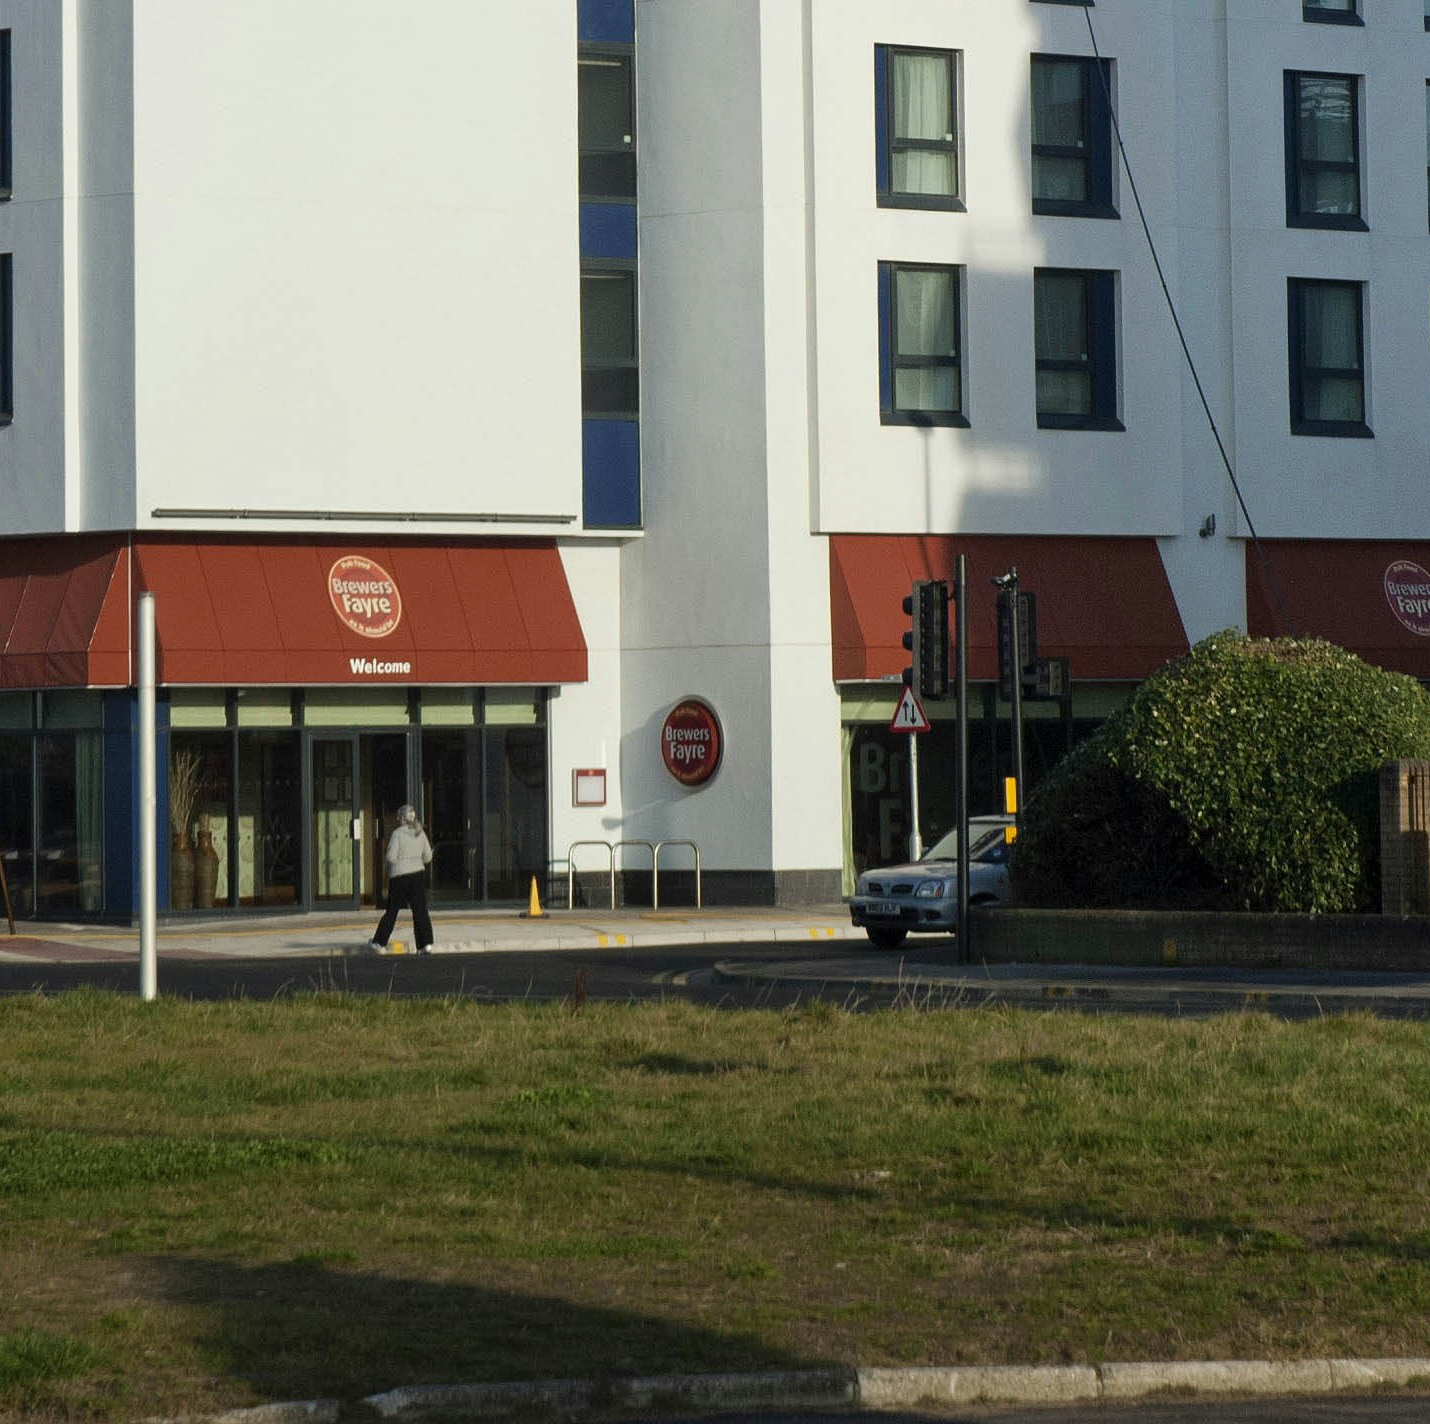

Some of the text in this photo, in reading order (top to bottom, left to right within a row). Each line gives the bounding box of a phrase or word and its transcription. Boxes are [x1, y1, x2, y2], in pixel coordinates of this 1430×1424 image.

[332, 578, 393, 595] Brewers
[342, 594, 392, 618] Fayre
[350, 658, 411, 674] Welcome
[665, 726, 710, 741] Brewers
[670, 742, 706, 765] Fayre
